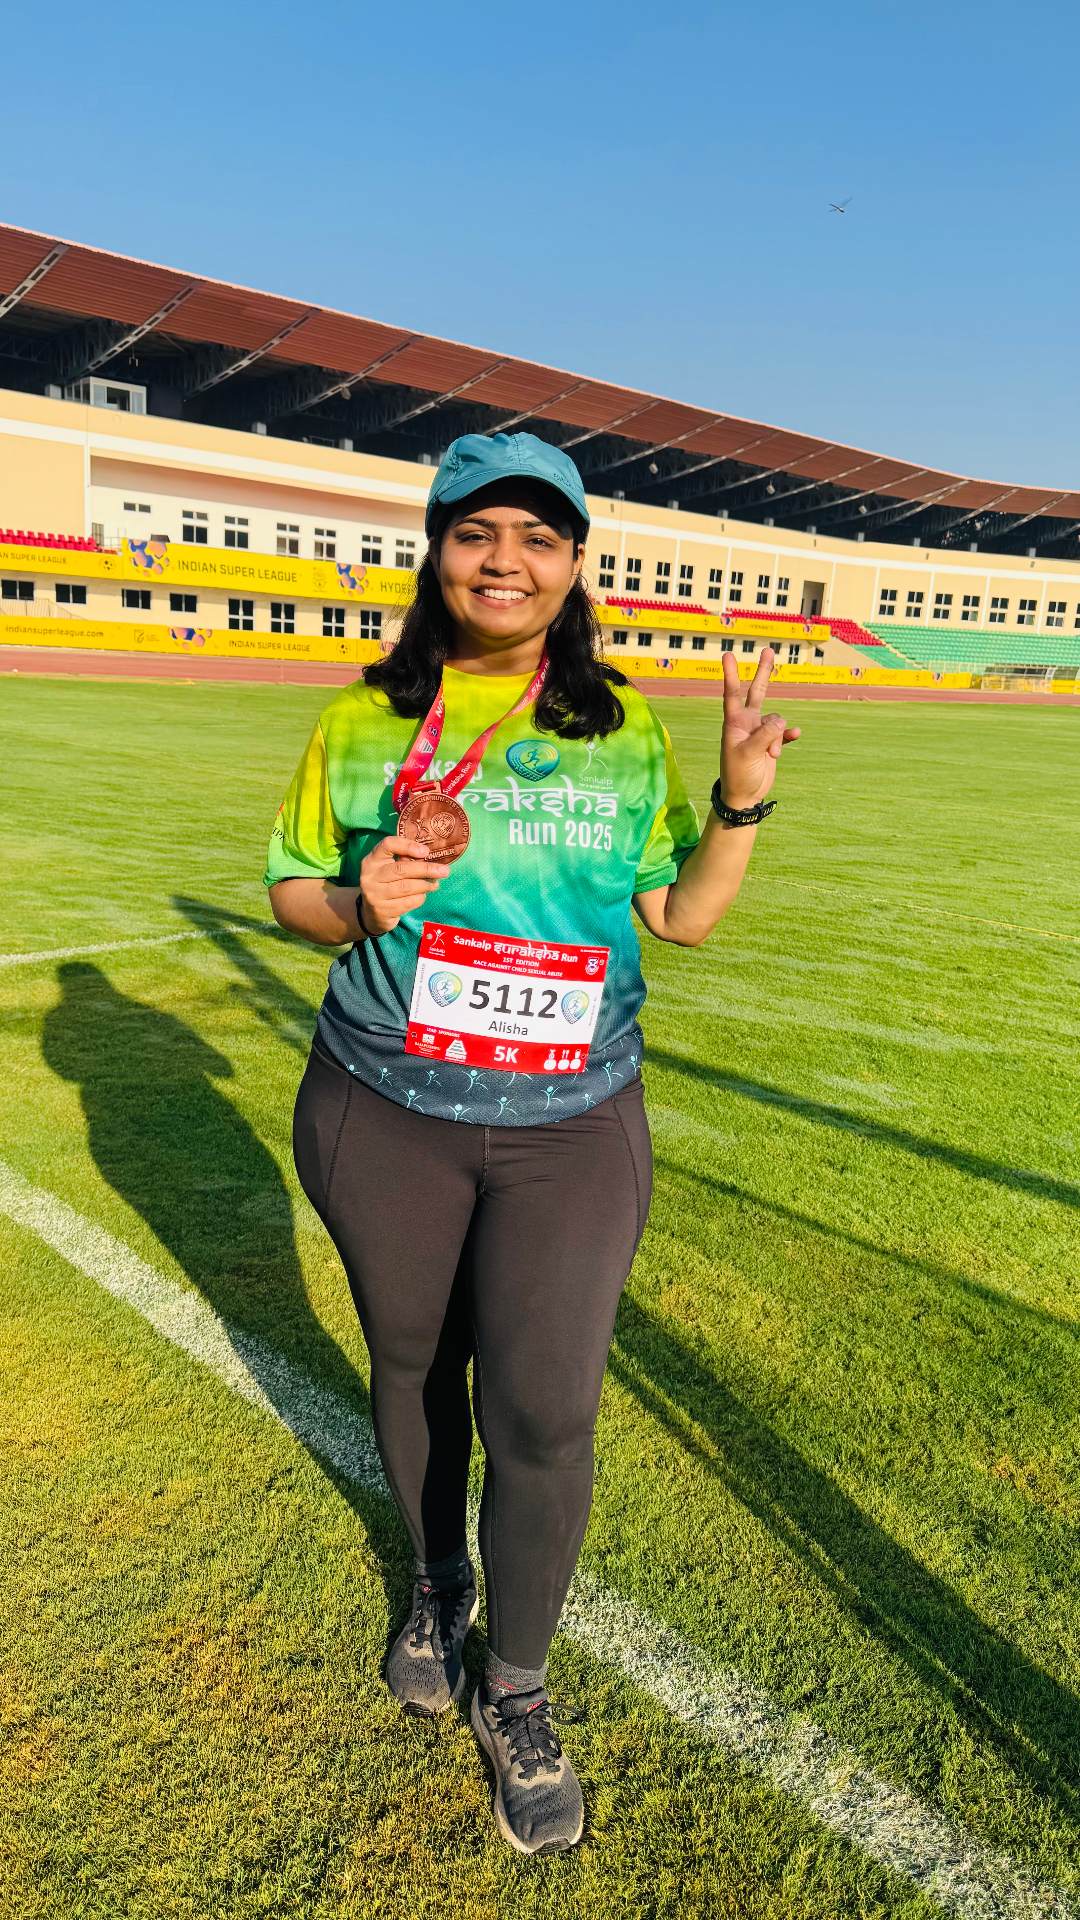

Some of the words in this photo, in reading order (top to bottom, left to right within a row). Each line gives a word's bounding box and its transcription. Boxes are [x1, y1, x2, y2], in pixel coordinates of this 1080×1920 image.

[10, 552, 36, 562] SUPER
[38, 555, 67, 565] LEAGUE
[178, 560, 217, 574] INDIAN
[220, 564, 255, 578] SUPER
[258, 568, 298, 583] LEAGUE
[5, 625, 104, 638] indiansuperleague.com
[229, 639, 256, 649] INDIAN
[257, 642, 282, 651] SUPER
[283, 643, 311, 652] LEAGUE
[443, 773, 465, 794] Suraksha
[461, 761, 473, 774] Run
[578, 774, 613, 786] Sankalp
[509, 818, 557, 845] Run
[564, 820, 613, 851] 2025
[453, 935, 492, 951] Sankalp
[561, 952, 578, 963] Run
[487, 962, 511, 971] AGAINST
[527, 968, 547, 976] SEXUAL
[515, 958, 540, 967] EDITION
[469, 979, 558, 1019] 5112
[488, 1020, 528, 1036] Alisha
[493, 1045, 519, 1064] 5K
